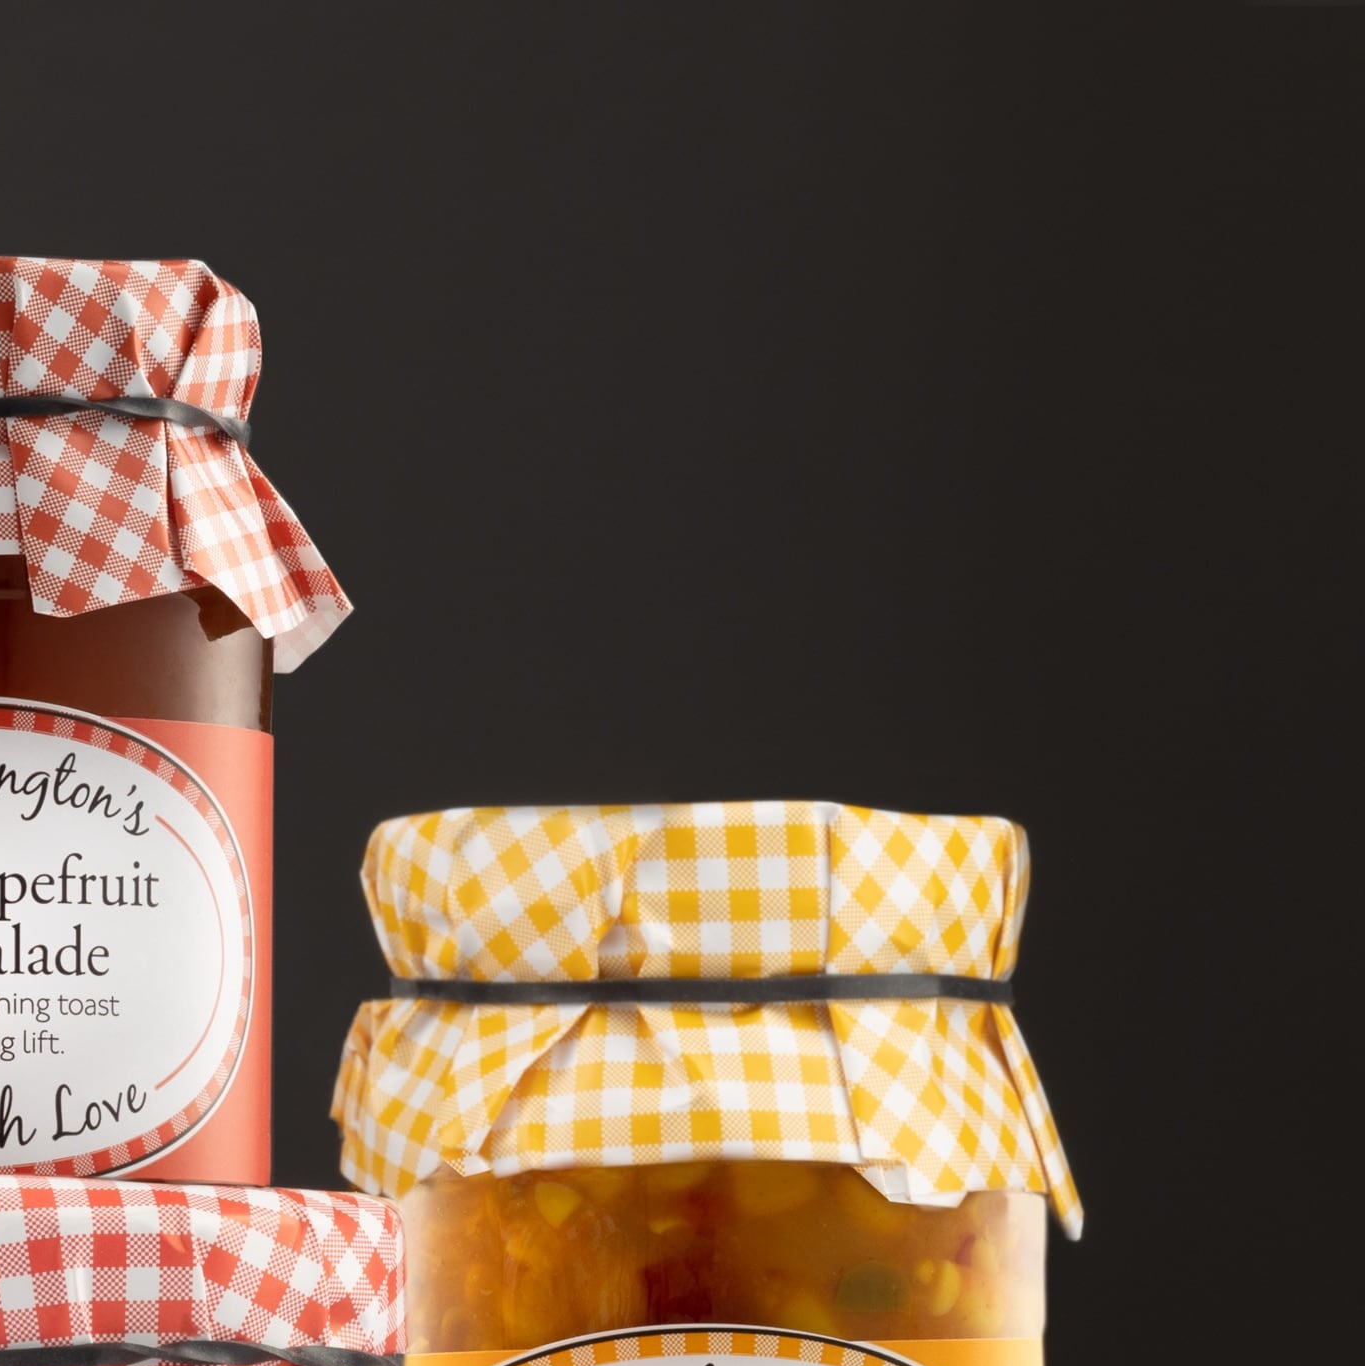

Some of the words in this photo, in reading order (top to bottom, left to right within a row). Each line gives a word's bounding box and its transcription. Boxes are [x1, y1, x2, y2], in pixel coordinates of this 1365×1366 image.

[57, 994, 120, 1017] toast
[23, 1029, 65, 1055] lift.
[51, 1083, 147, 1142] Love
